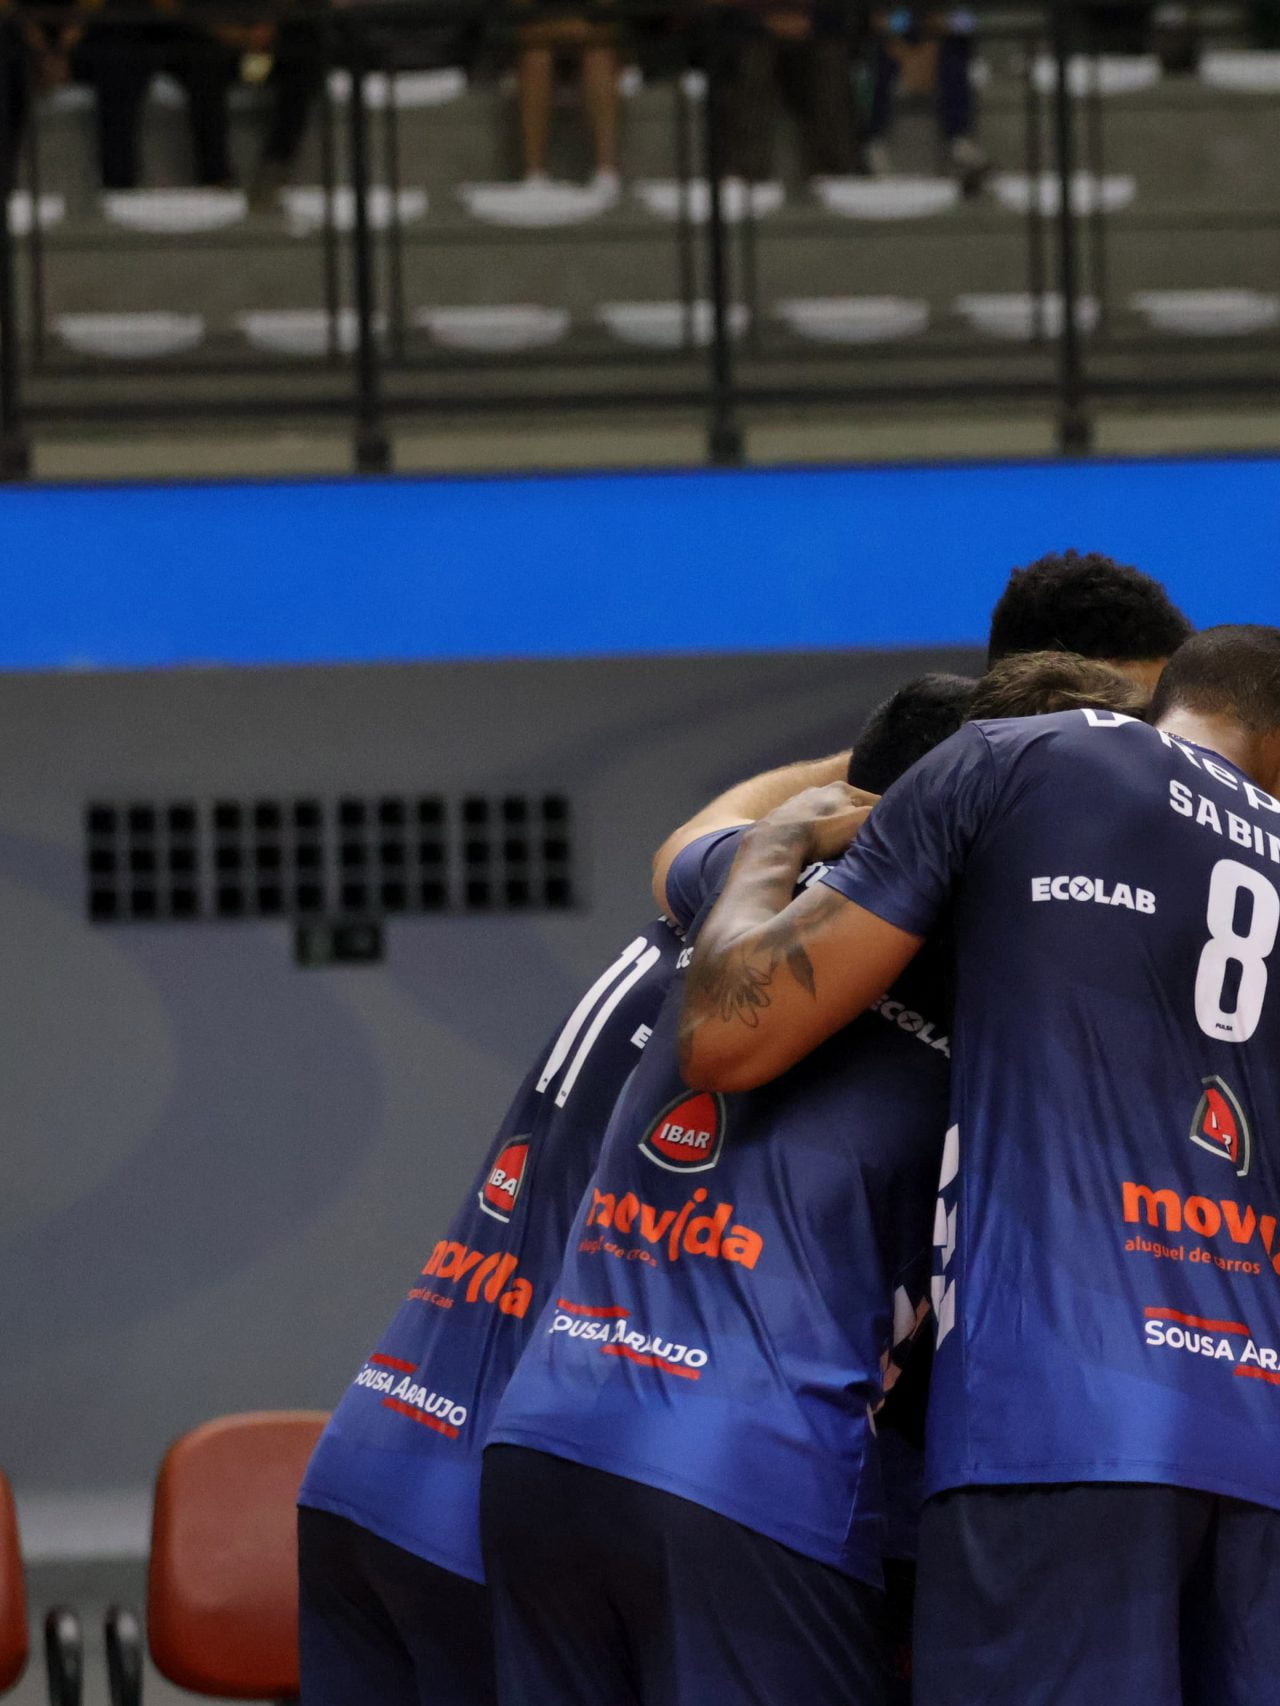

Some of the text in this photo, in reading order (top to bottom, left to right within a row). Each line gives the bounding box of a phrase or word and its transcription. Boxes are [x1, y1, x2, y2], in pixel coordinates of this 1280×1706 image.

[1031, 875, 1156, 914] ECOLAB
[1195, 859, 1280, 1043] 8
[535, 936, 661, 1108] 11
[876, 997, 951, 1059] COLA
[660, 1123, 710, 1150] IBAR
[489, 1167, 518, 1197] IBA
[1125, 1236, 1184, 1261] aluguel
[1188, 1248, 1212, 1263] de
[1144, 1320, 1235, 1361] SOUSA
[390, 1375, 467, 1426] ARAUJO
